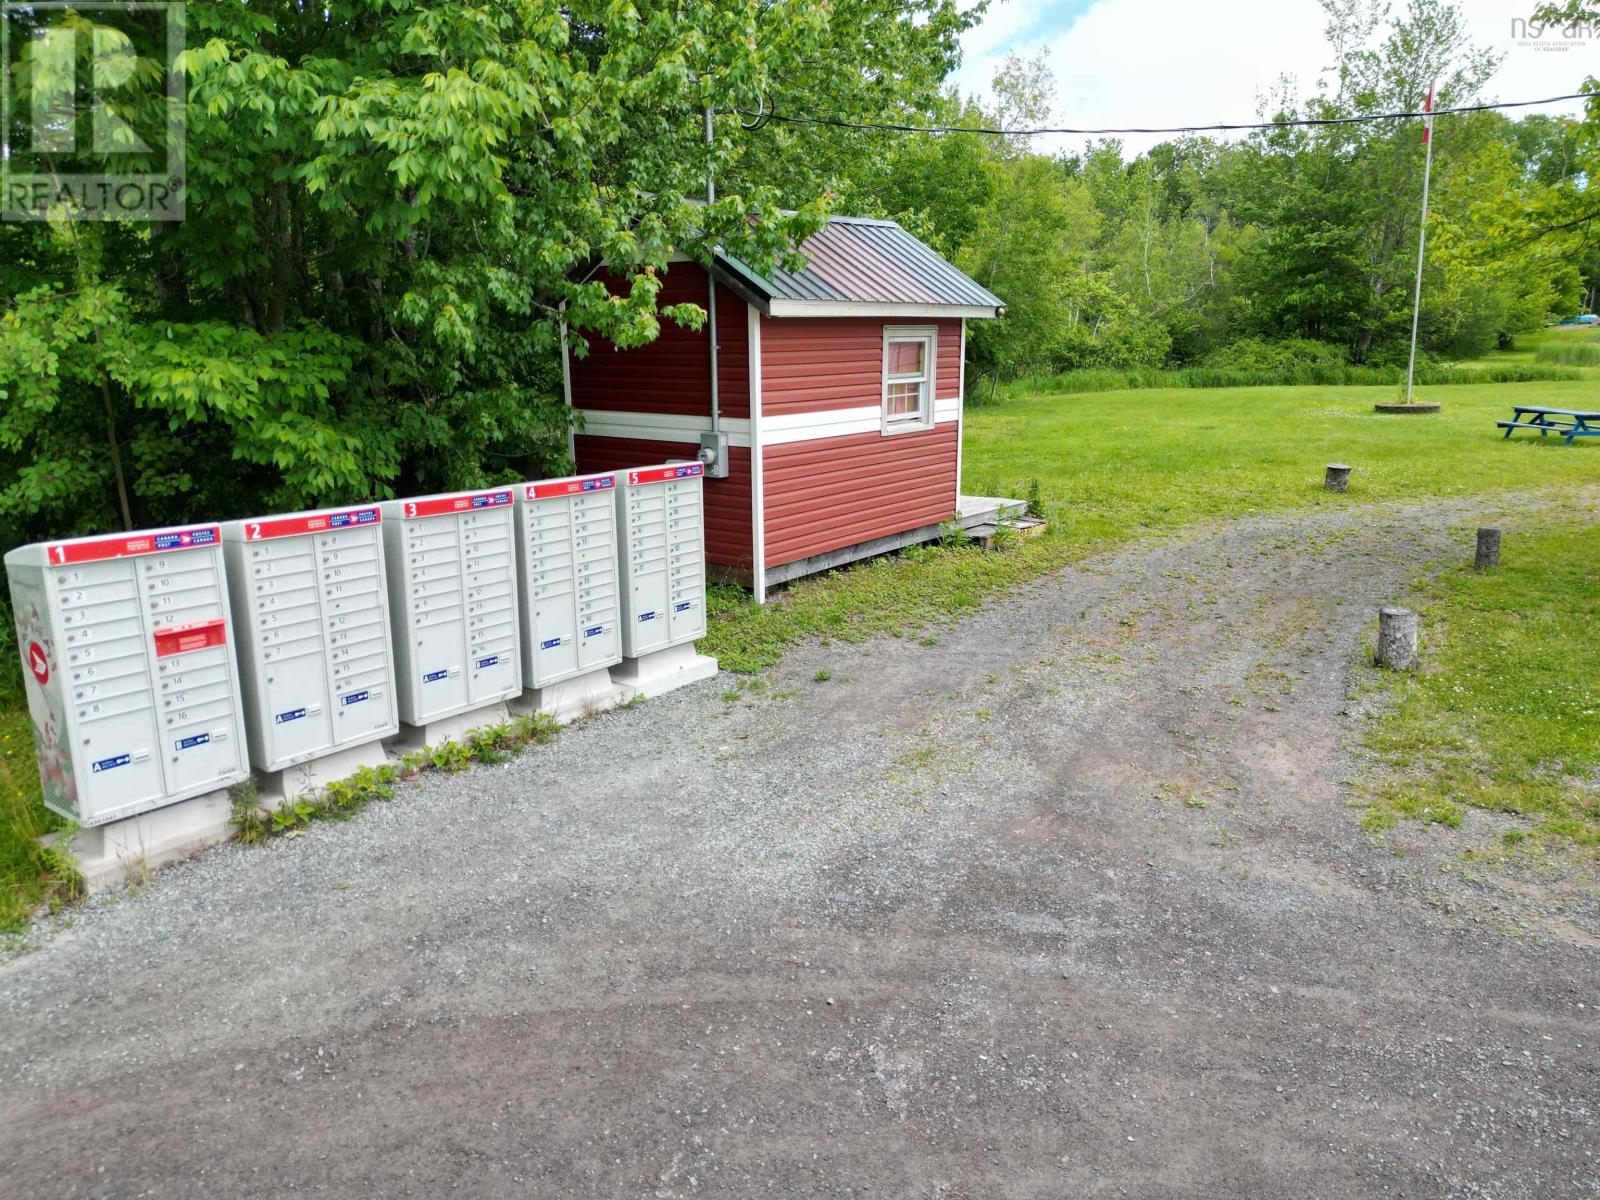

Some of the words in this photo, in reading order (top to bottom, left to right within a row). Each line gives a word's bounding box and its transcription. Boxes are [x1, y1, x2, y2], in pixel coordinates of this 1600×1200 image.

[632, 473, 638, 483] 5
[528, 487, 536, 498] 4
[409, 504, 416, 517] 3
[251, 525, 261, 538] 2
[55, 547, 65, 563] 1
[159, 560, 165, 568] 9
[76, 592, 82, 600] 2
[93, 704, 100, 713] 8
[94, 762, 101, 771] A
